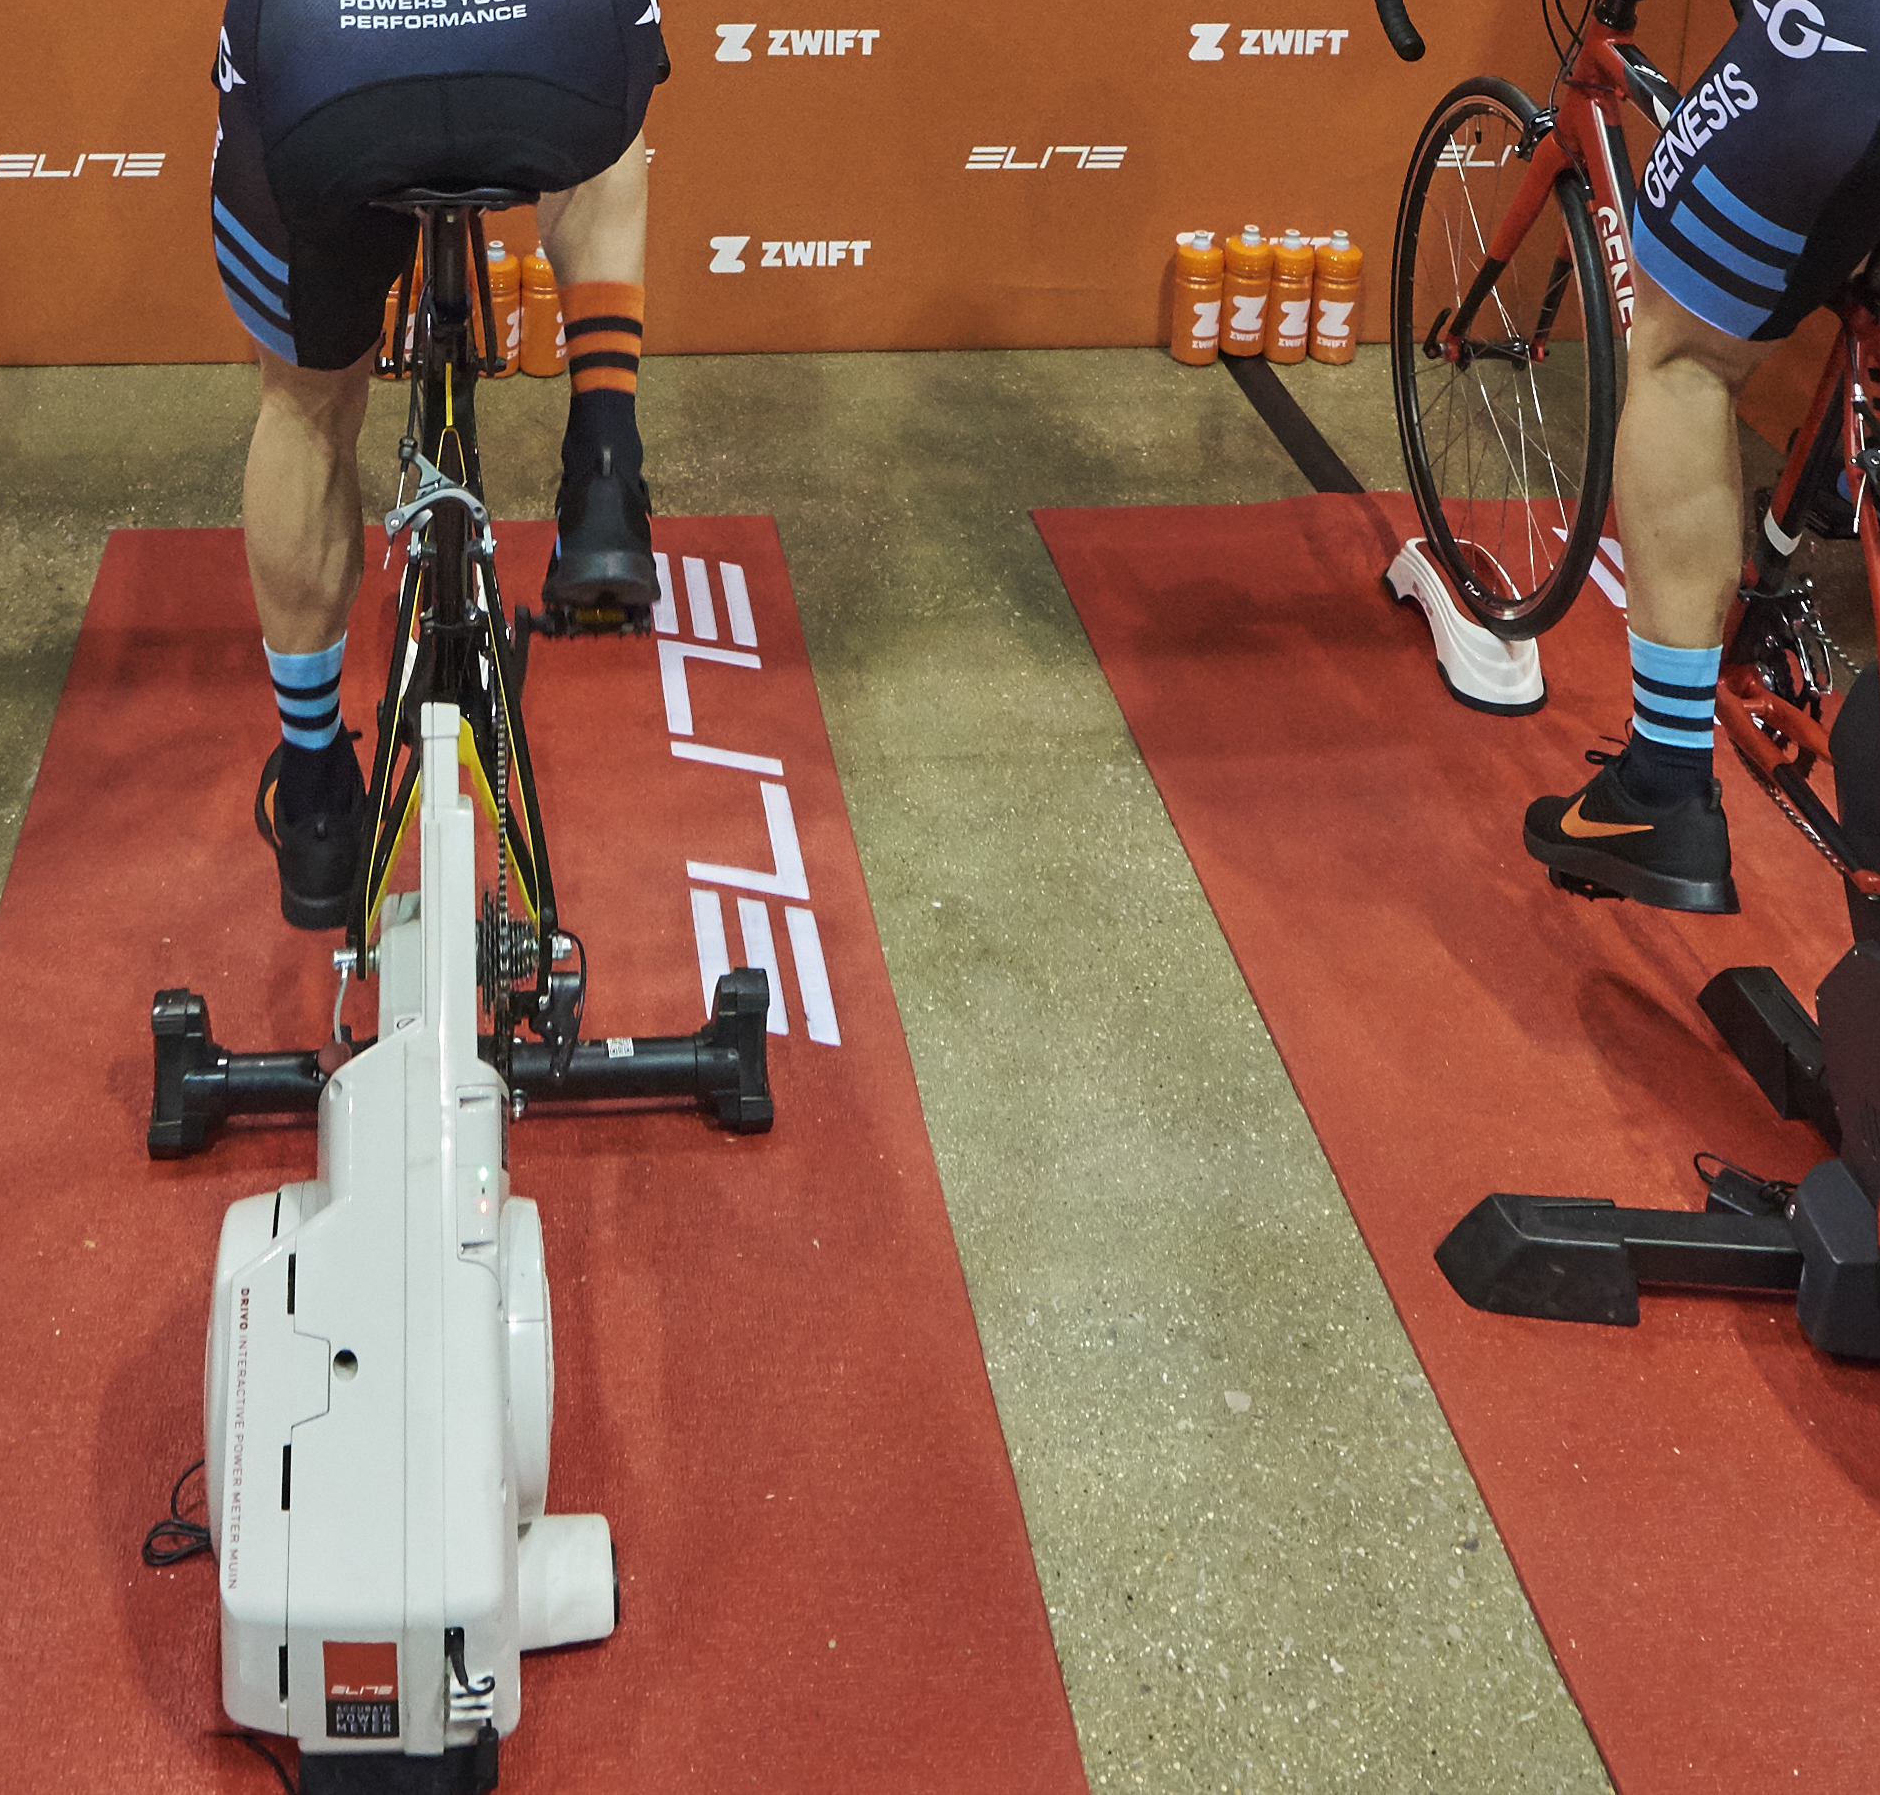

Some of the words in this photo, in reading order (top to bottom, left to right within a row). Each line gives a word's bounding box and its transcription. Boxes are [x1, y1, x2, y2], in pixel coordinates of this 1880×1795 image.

[340, 4, 528, 29] PERFORMANCE
[768, 30, 880, 55] ZWIFT
[1239, 30, 1348, 55] ZWIFT
[1639, 62, 1759, 209] GENESIS
[966, 147, 1127, 169] ELITE
[761, 241, 871, 267] ZWIFT
[1597, 206, 1635, 352] GENE
[1229, 331, 1261, 342] ZWIFT
[1316, 336, 1348, 348] ZWIFT
[239, 1288, 250, 1331] DRIVO
[233, 1336, 248, 1428] INTERACTIVE
[232, 1435, 244, 1488] POWER
[230, 1491, 243, 1544] METER
[227, 1549, 240, 1590] MUIN
